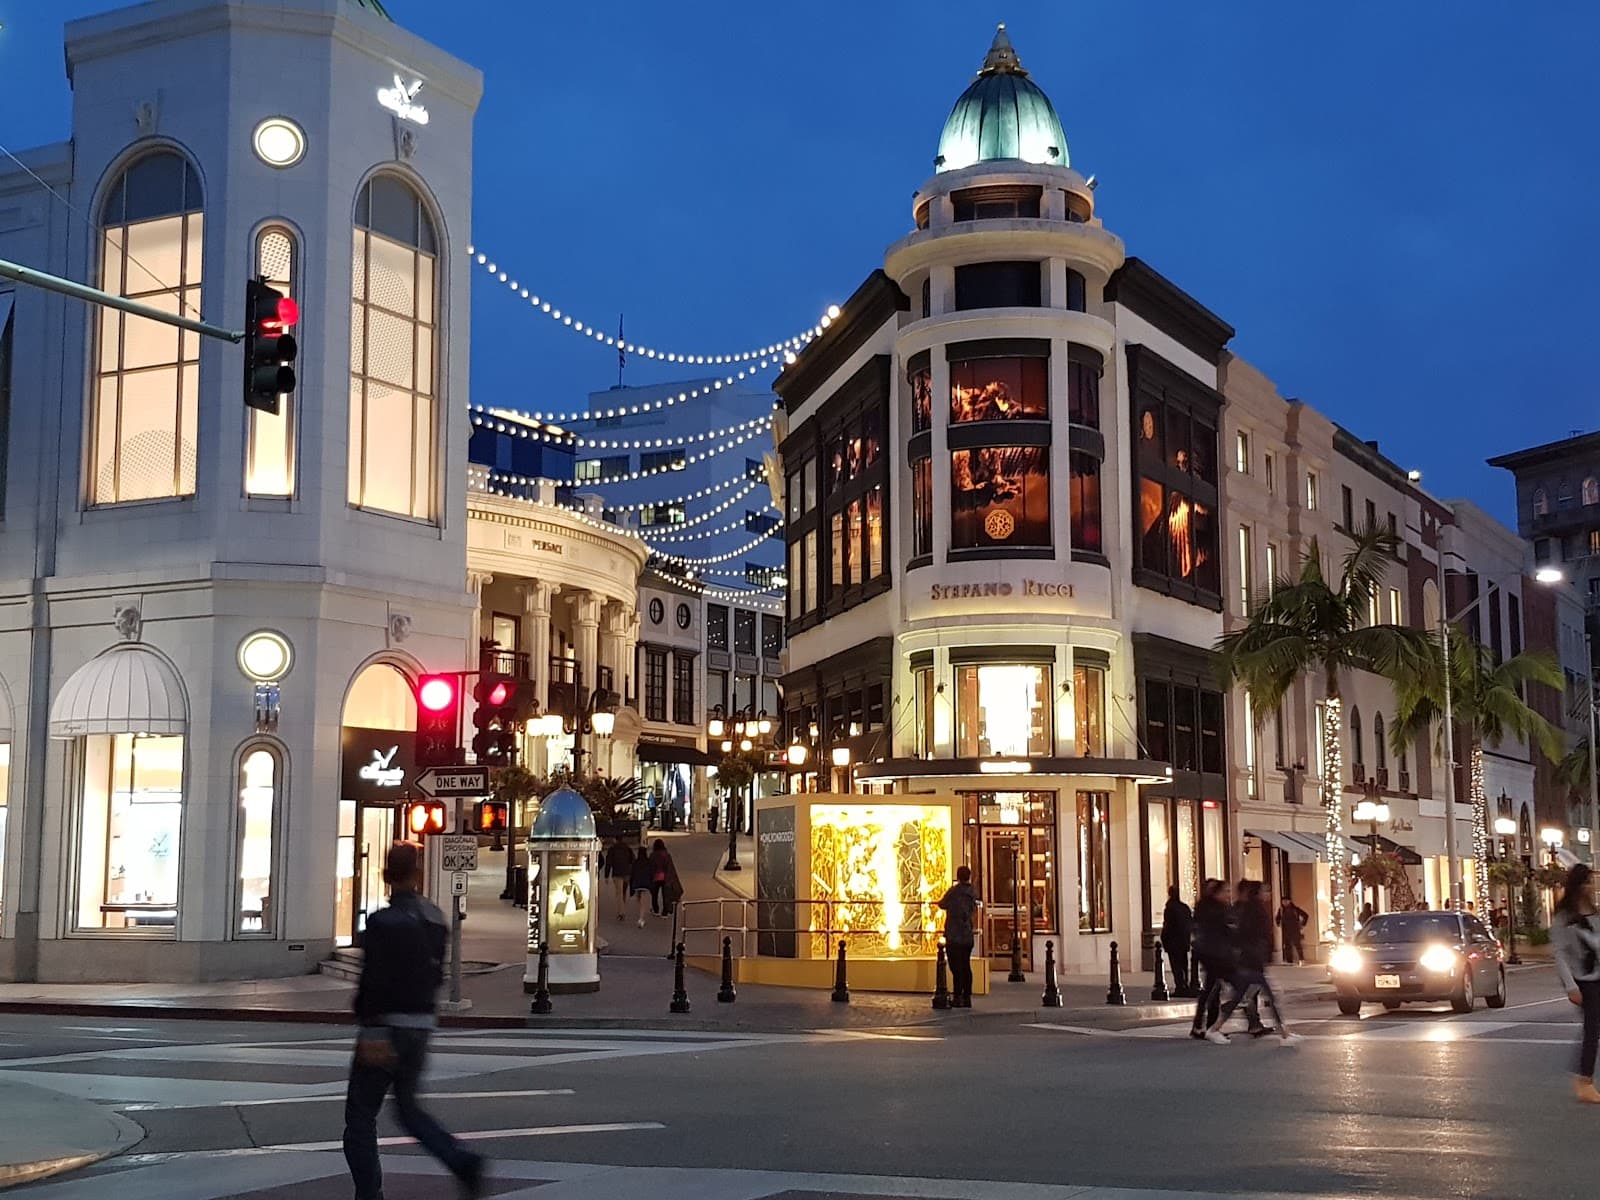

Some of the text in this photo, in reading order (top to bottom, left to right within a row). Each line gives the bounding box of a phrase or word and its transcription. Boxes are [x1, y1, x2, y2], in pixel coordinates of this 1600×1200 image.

[931, 579, 1075, 600] STEFANO RICCI
[436, 776, 480, 788] ONE WAY
[444, 855, 457, 867] OK
